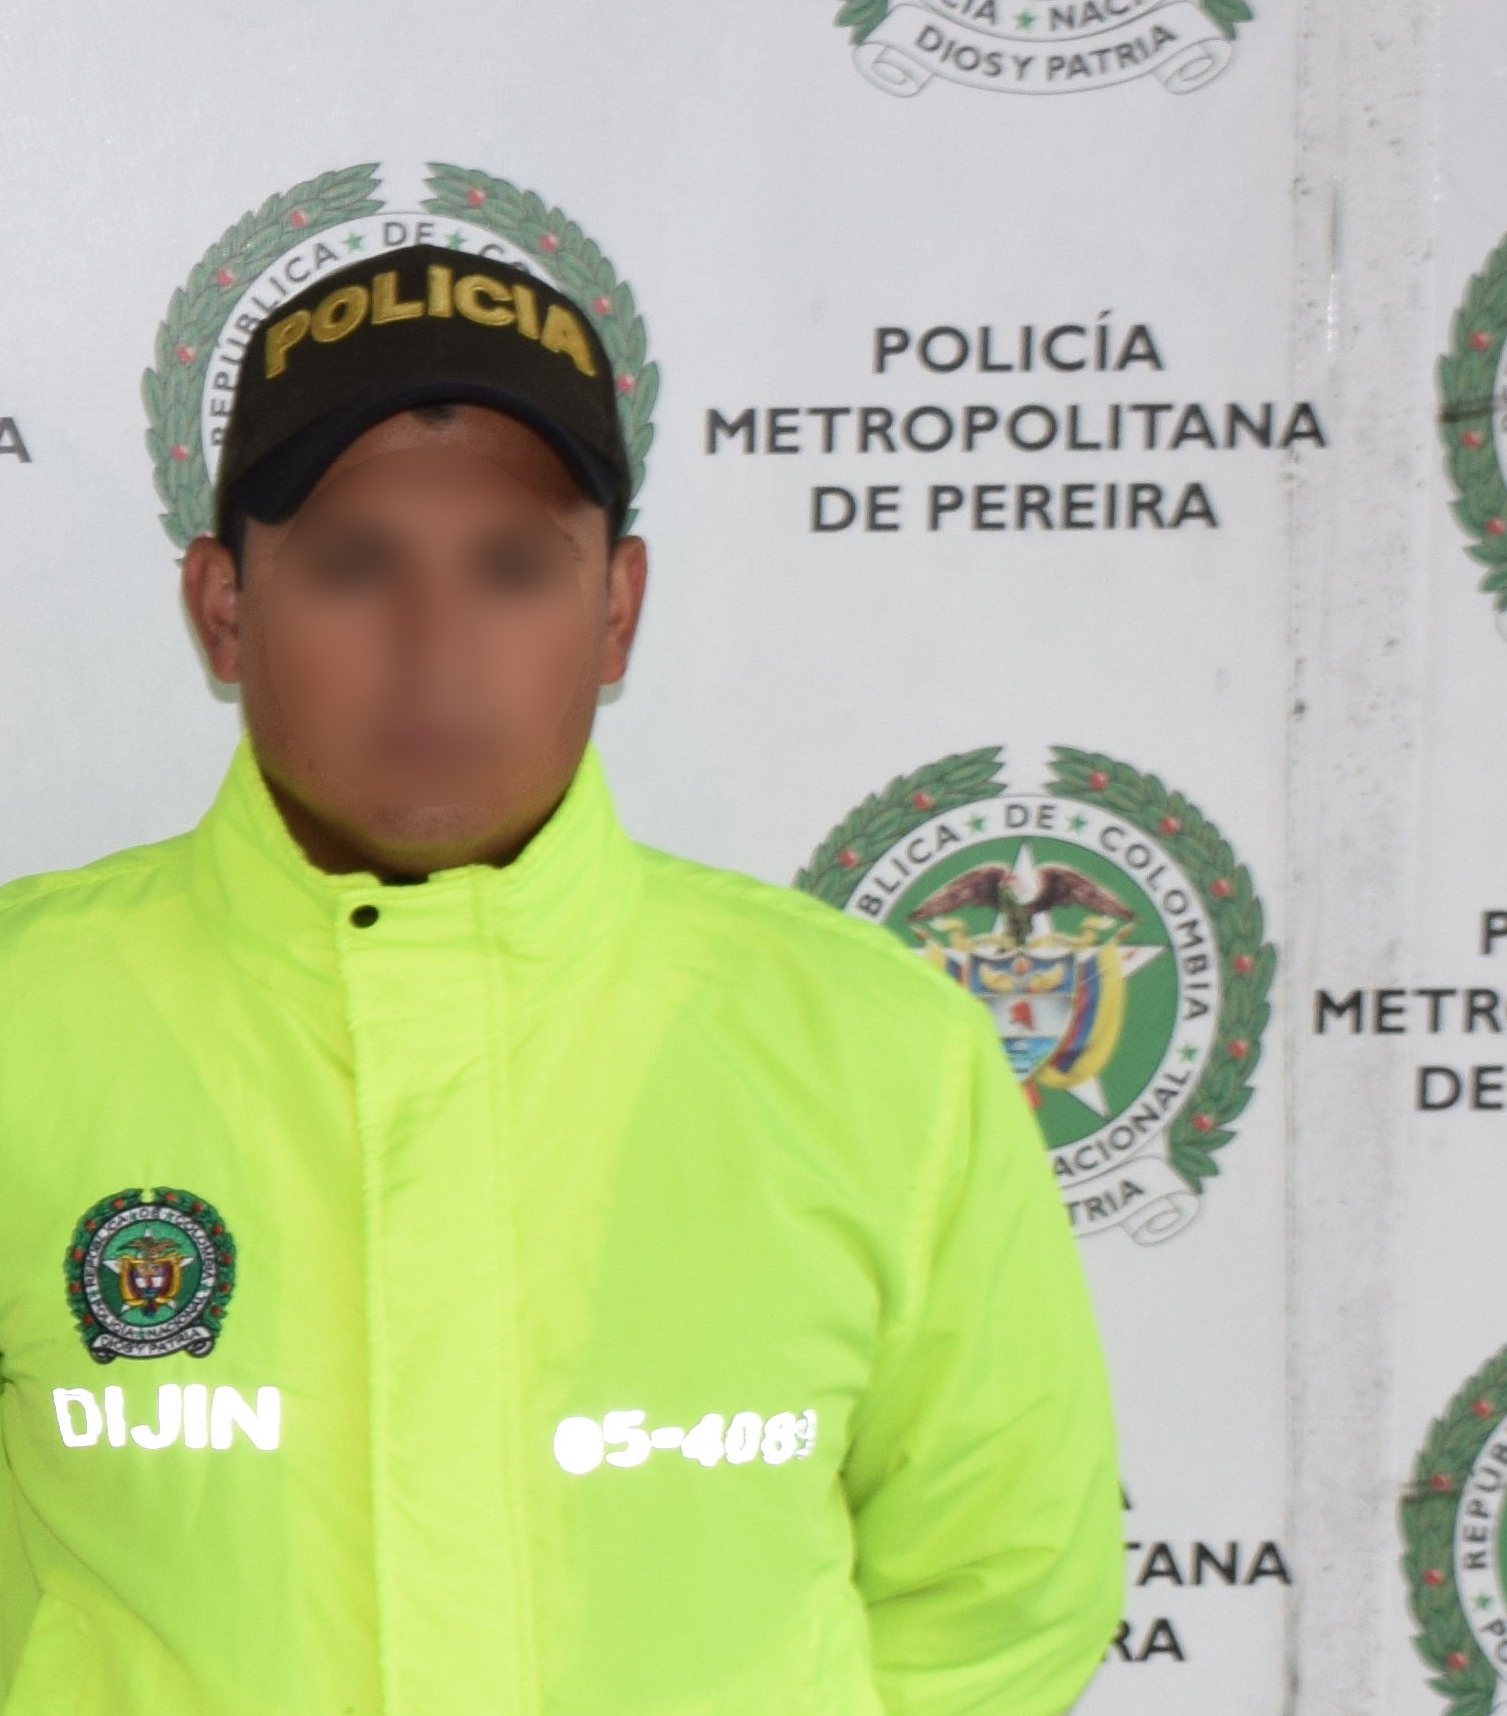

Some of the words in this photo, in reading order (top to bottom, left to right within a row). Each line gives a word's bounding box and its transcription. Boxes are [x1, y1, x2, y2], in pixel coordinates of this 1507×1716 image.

[915, 25, 1002, 76] DIOS
[1046, 25, 1177, 81] PATRIA
[383, 222, 436, 247] DE
[265, 264, 597, 379] POLICIA
[874, 311, 1164, 373] POLICÍA
[706, 402, 1328, 453] METROPOLITANA
[811, 486, 900, 532] DE
[928, 483, 1218, 530] PEREIRA
[1005, 804, 1055, 829] DE
[1099, 825, 1210, 1021] COLOMBIA
[1417, 1066, 1504, 1111] DE
[52, 1385, 282, 1452] DIJIN
